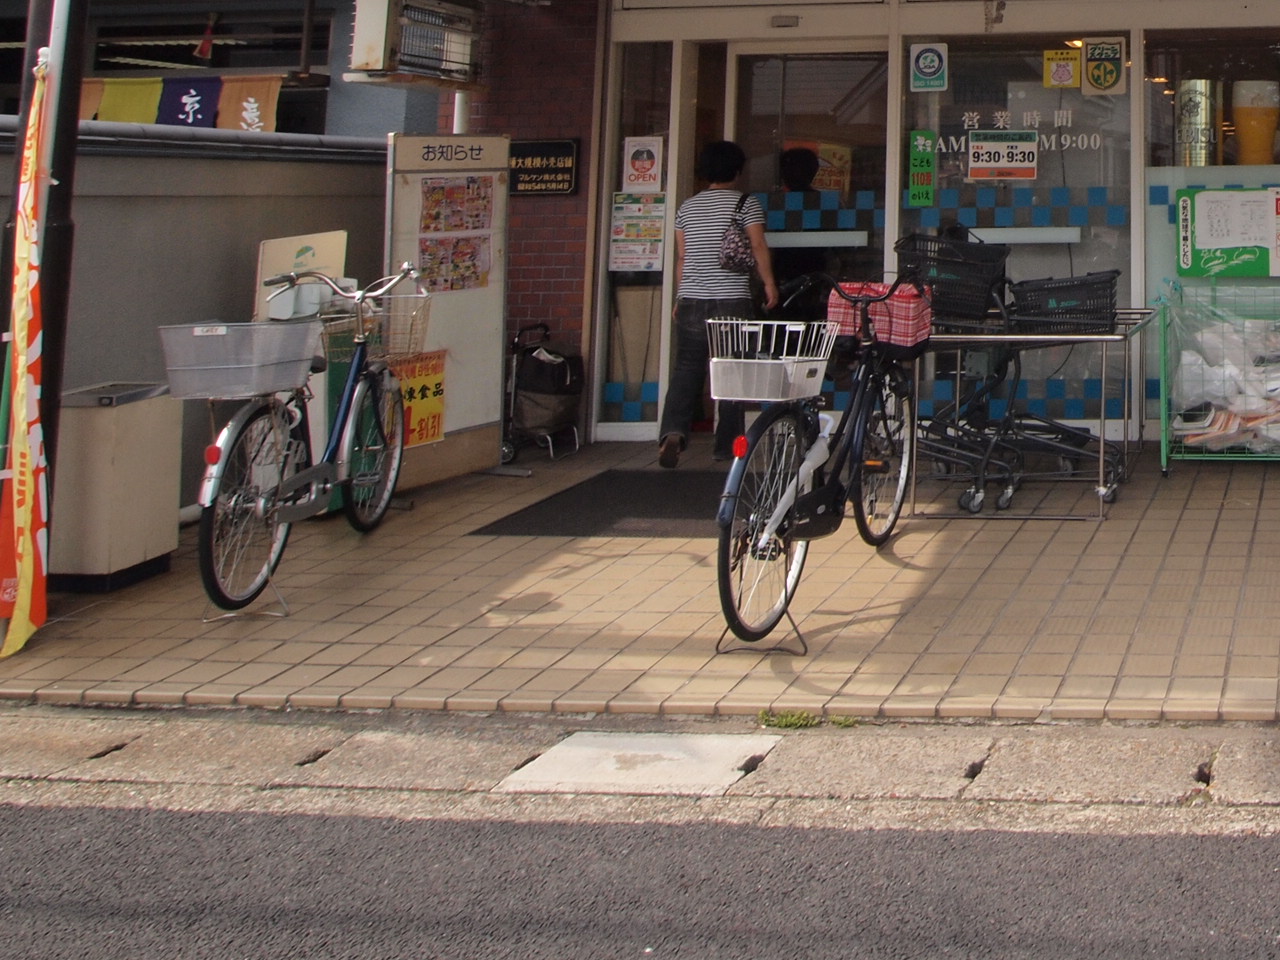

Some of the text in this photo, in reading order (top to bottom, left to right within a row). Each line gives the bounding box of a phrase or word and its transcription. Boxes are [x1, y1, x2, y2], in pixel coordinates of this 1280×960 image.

[178, 89, 202, 123] 京
[961, 110, 1073, 130] 営業時間
[934, 136, 967, 153] AM
[421, 144, 484, 161] お知らせ
[972, 151, 1035, 163] 9:30 9:30
[912, 158, 931, 168] こども
[628, 173, 657, 182] OPEN
[911, 172, 932, 186] 110番
[911, 190, 930, 201] のいえ
